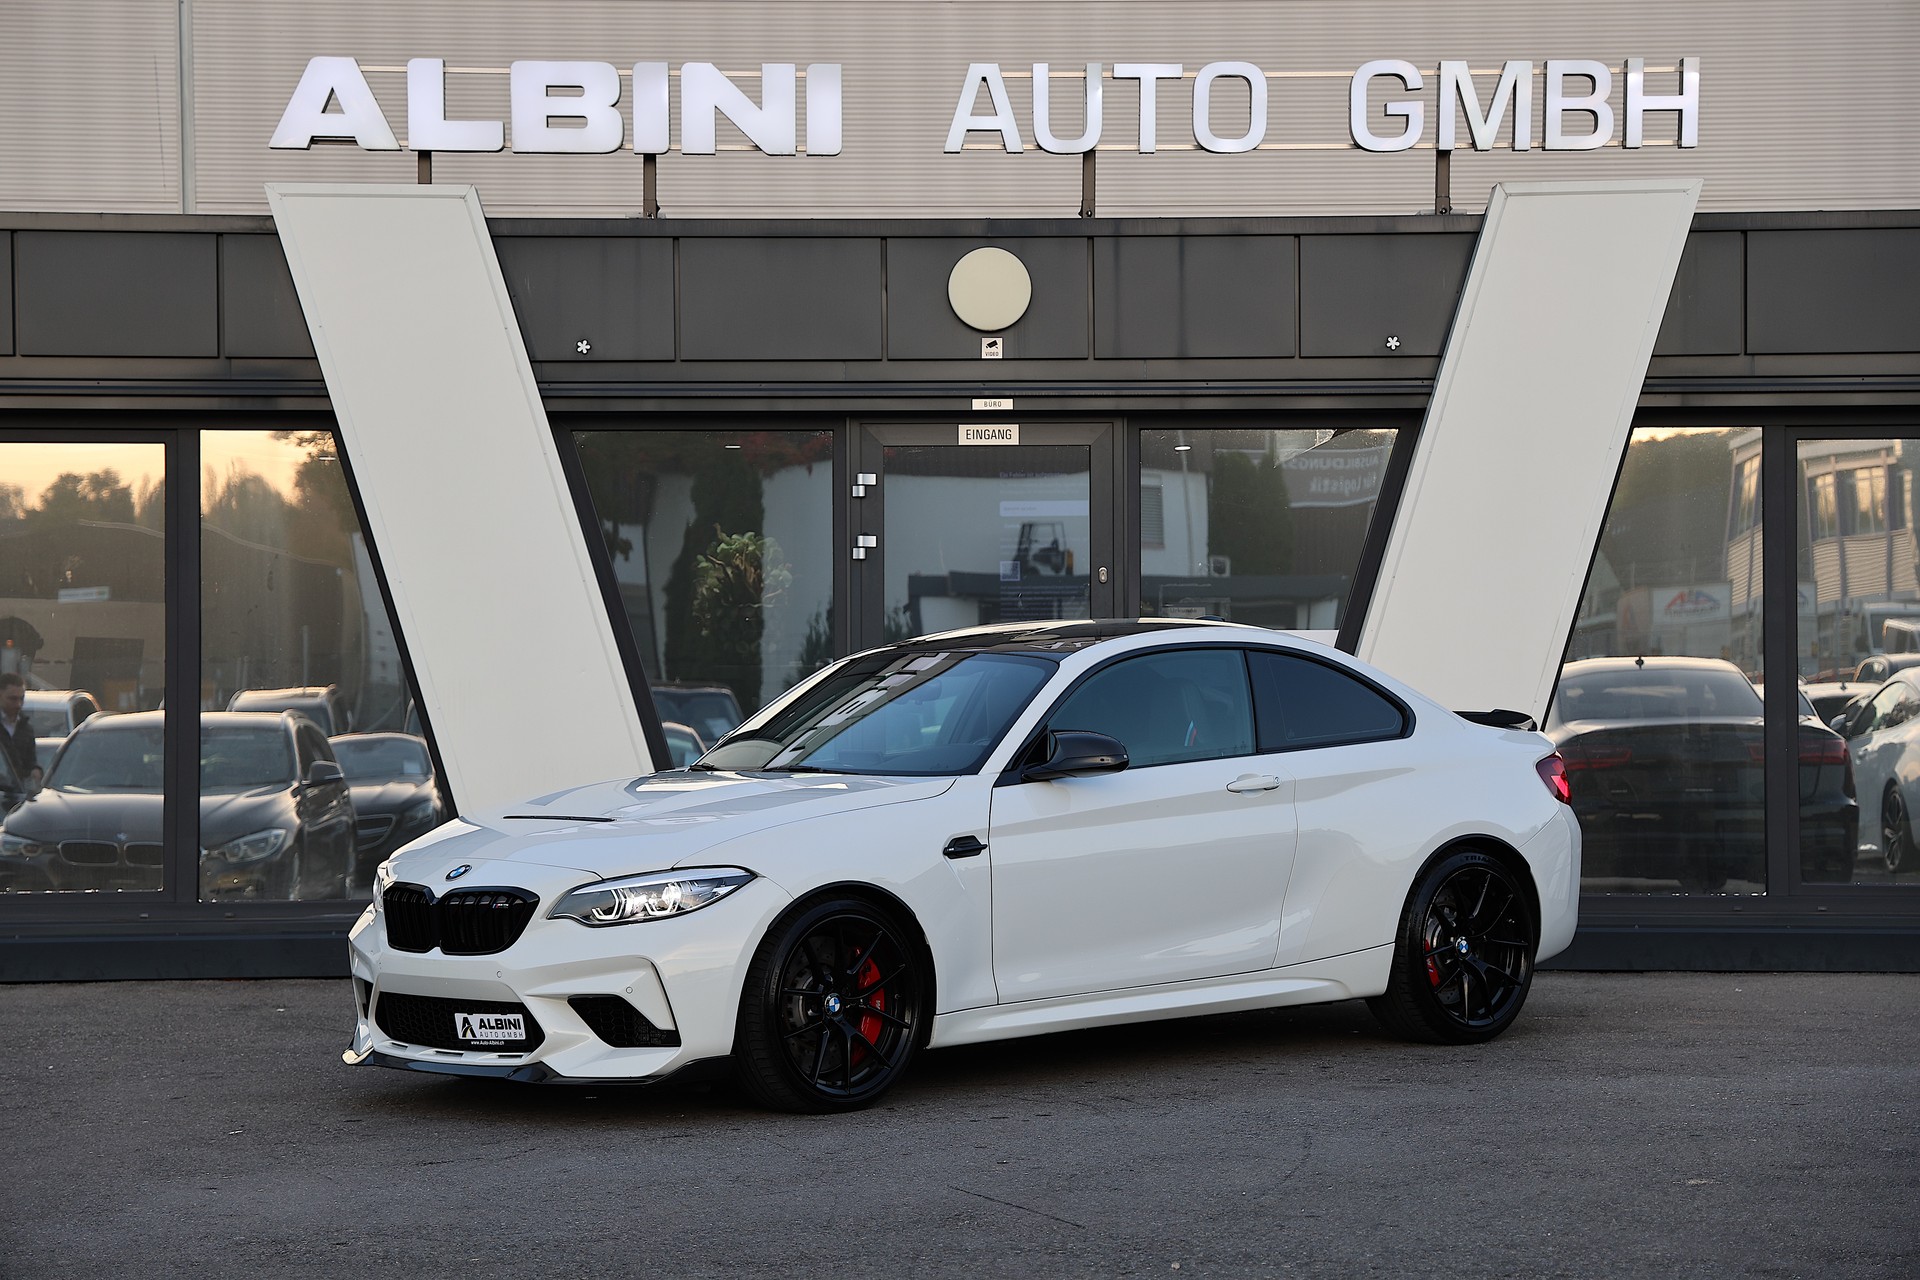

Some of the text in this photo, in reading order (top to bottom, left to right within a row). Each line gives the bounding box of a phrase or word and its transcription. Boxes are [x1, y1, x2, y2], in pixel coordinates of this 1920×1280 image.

[268, 56, 1701, 156] ALBINI AUTO GMBH
[983, 400, 1002, 408] BÜRO
[966, 429, 1012, 440] EINGANG
[479, 1018, 521, 1030] ALBINI
